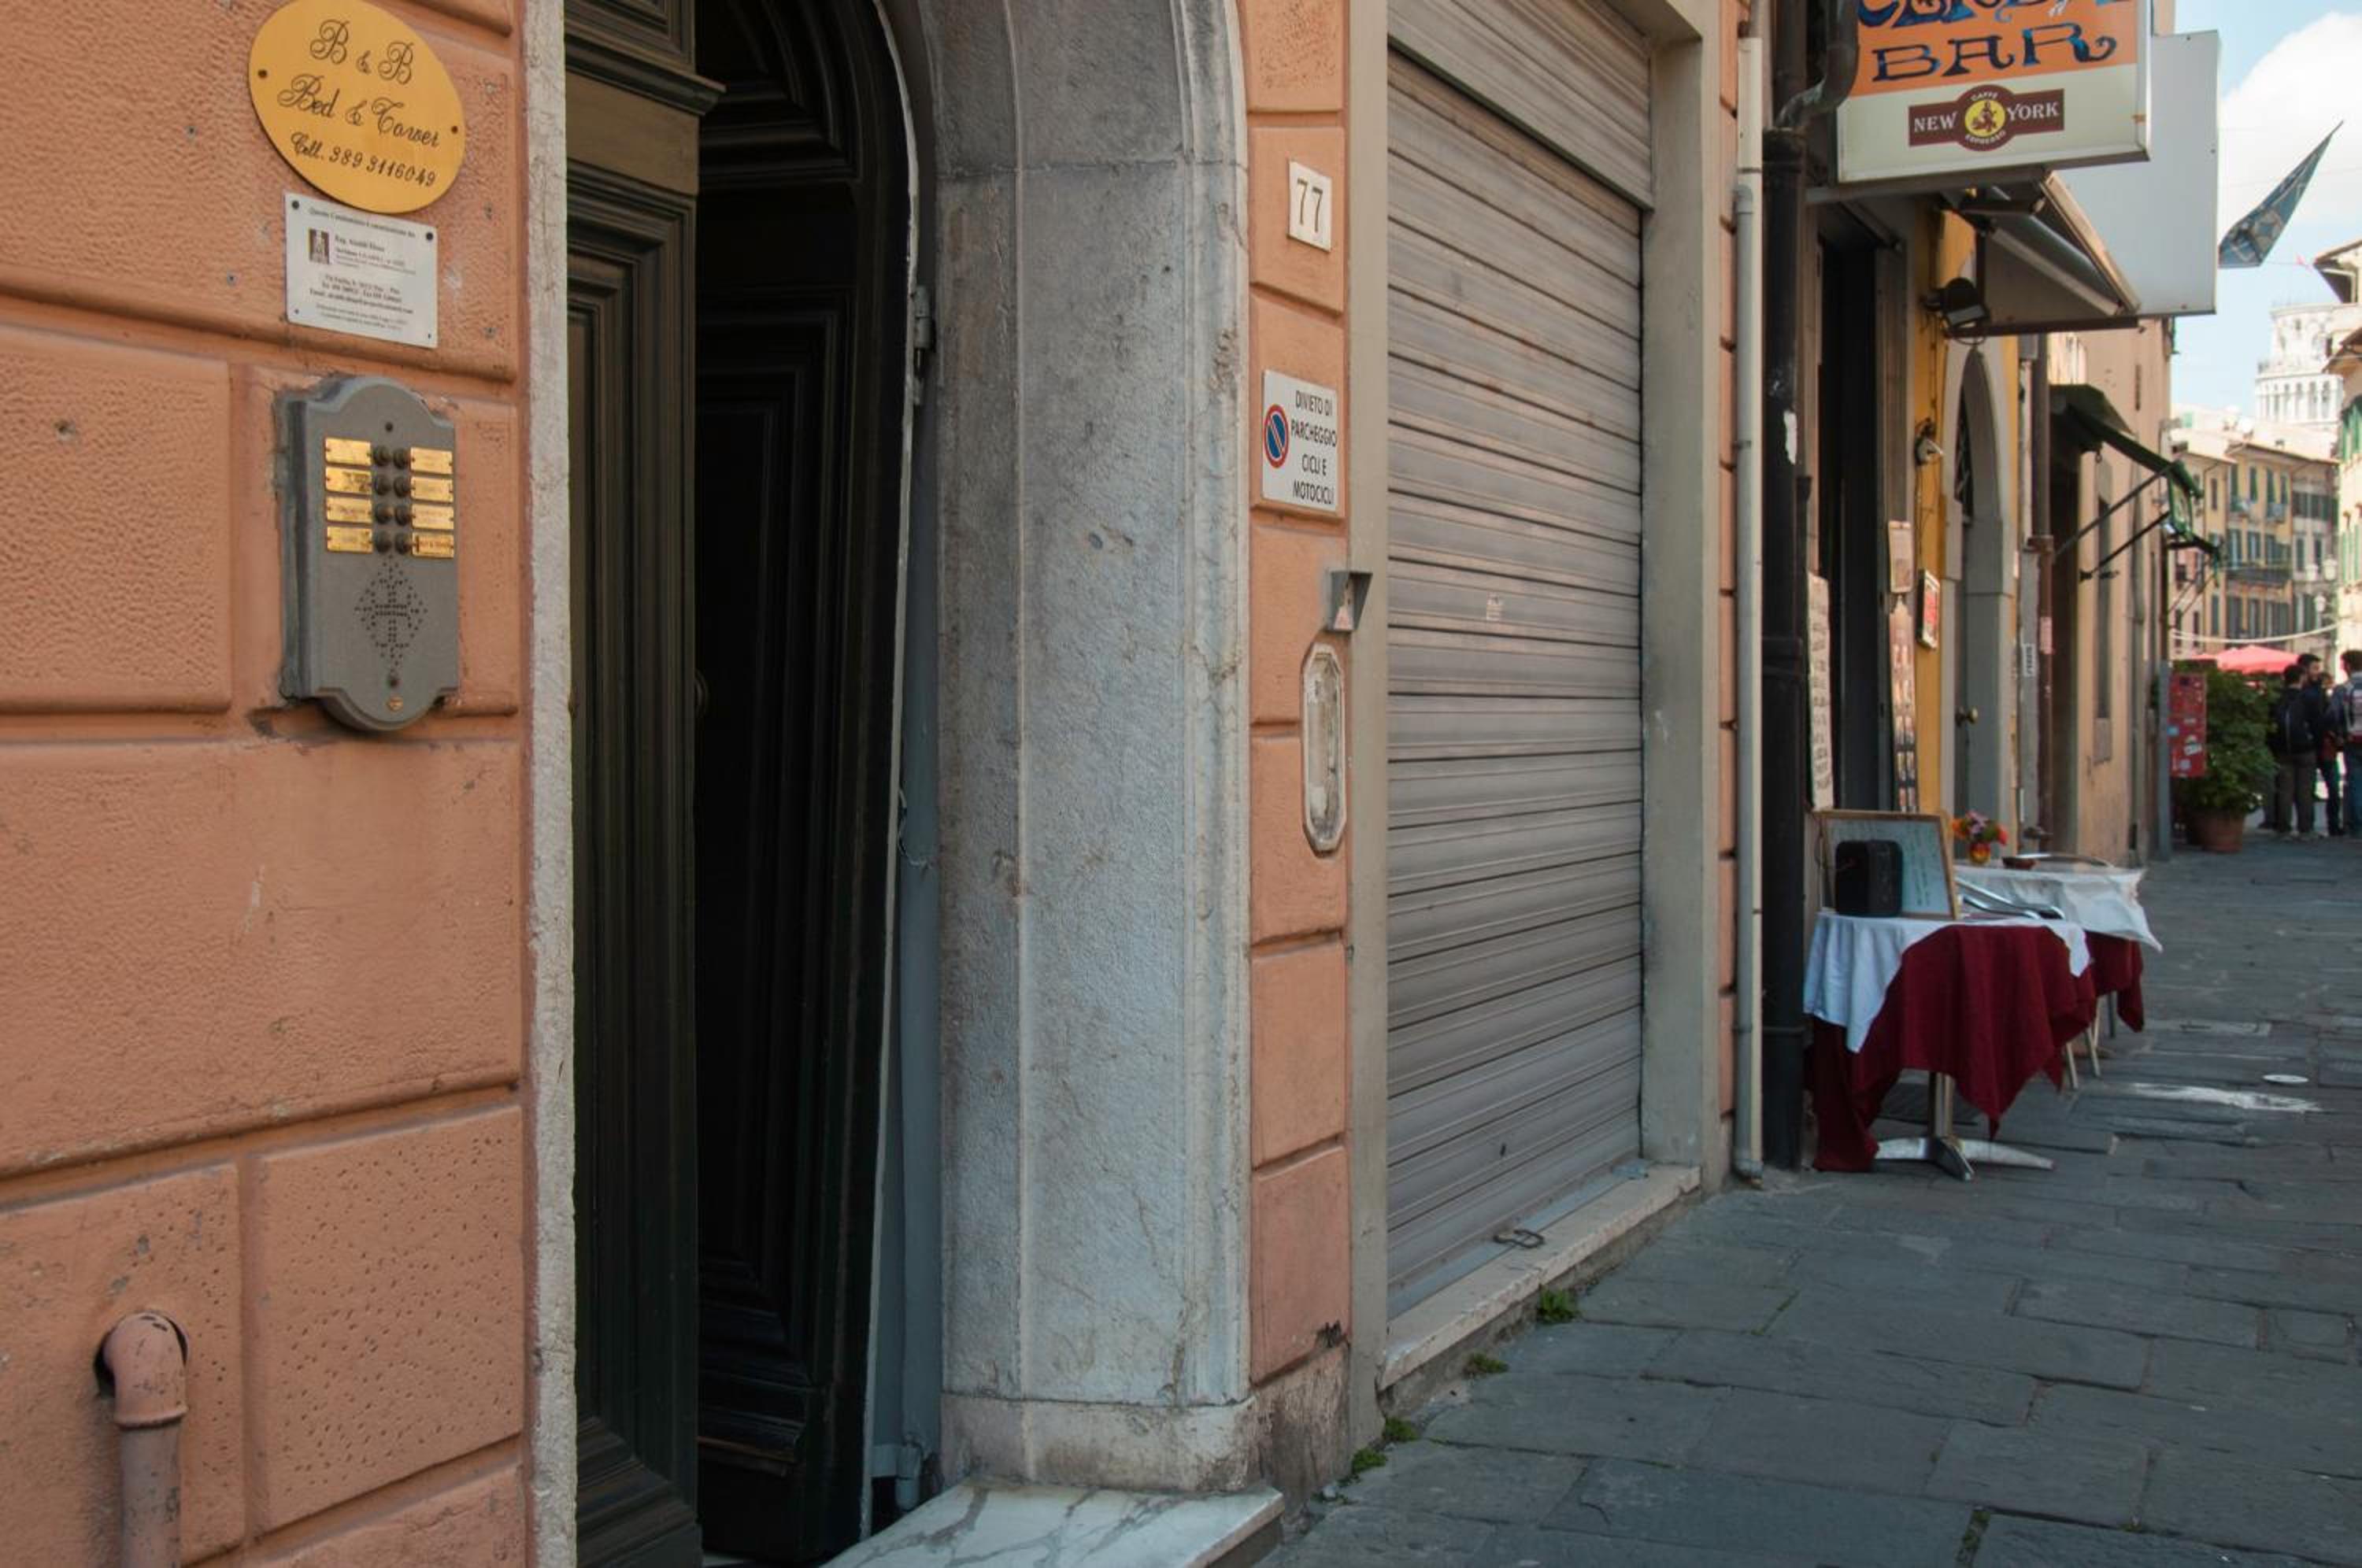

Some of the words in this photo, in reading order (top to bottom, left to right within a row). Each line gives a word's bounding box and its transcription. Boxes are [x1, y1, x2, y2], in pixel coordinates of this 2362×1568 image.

[309, 20, 350, 64] B
[357, 50, 371, 73] &
[378, 41, 414, 85] B
[1871, 23, 2116, 82] BAR
[277, 73, 340, 117] Bed
[345, 100, 368, 126] &
[372, 97, 440, 147] Tower
[1914, 111, 1958, 133] NEW
[2007, 102, 2060, 122] YORK
[291, 131, 324, 160] Cell.
[329, 146, 362, 168] 389
[366, 157, 435, 187] 3116049
[1298, 177, 1323, 233] 77
[1295, 390, 1324, 415] DIVIETO
[1325, 399, 1333, 416] DI
[1291, 419, 1337, 447] PARCHEGGIO
[1301, 453, 1320, 474] CICLI
[1322, 458, 1327, 476] E
[1293, 480, 1335, 504] MOTOCICLI
